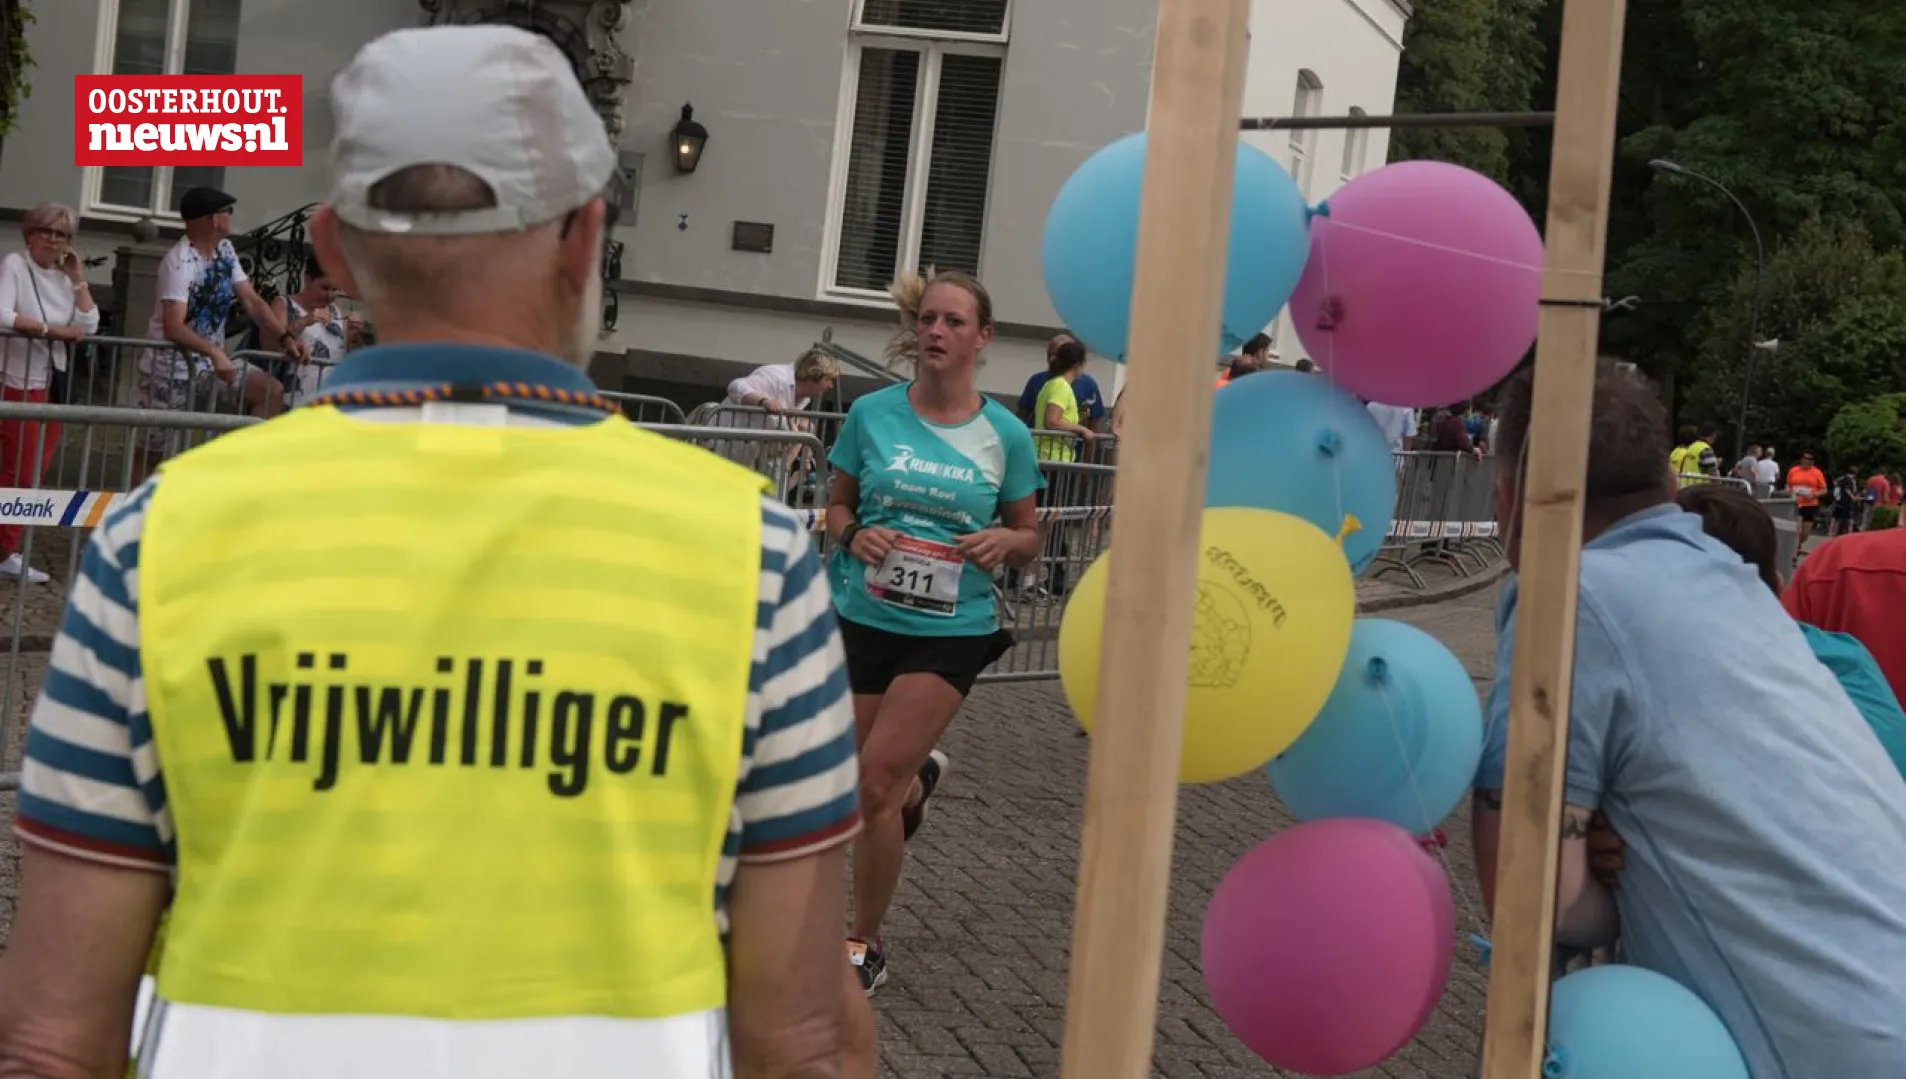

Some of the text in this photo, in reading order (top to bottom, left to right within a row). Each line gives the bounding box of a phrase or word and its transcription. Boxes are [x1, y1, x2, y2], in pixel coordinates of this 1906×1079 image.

[893, 480, 926, 494] Team
[0, 496, 55, 519] obank
[889, 566, 935, 593] 311
[206, 653, 689, 798] Vrijwilliger
